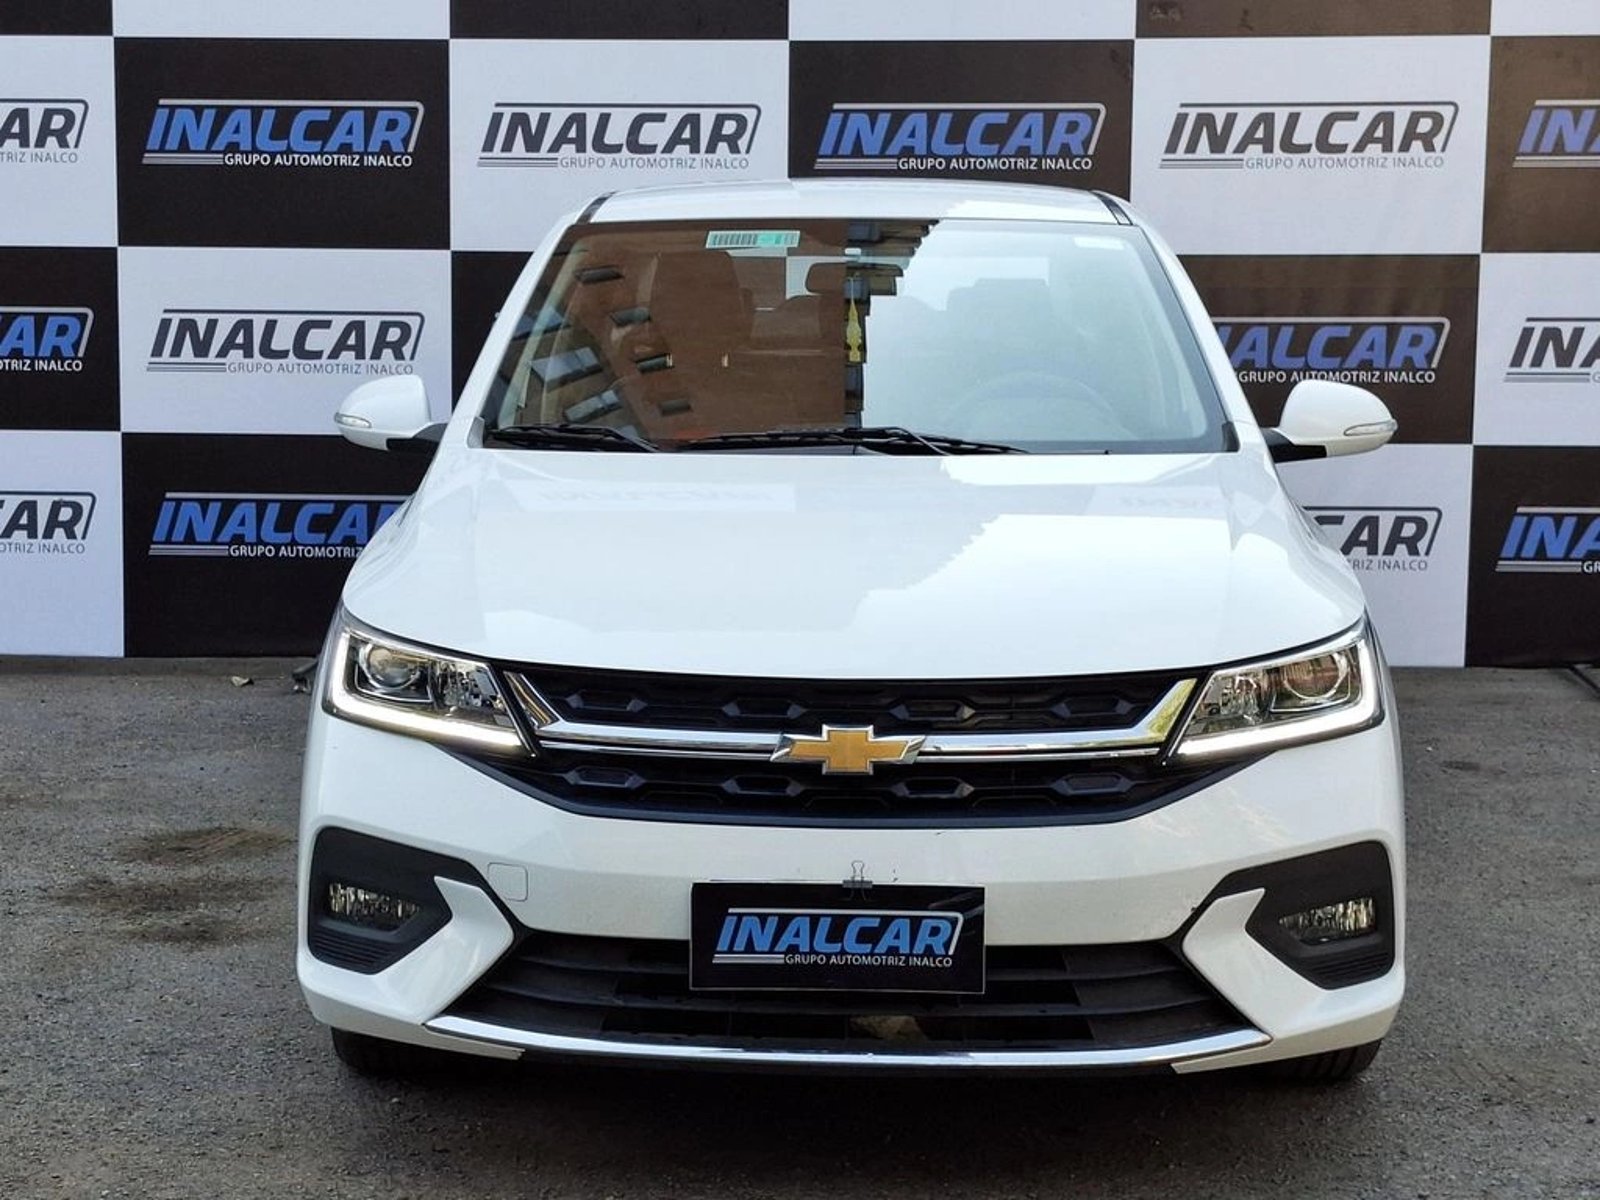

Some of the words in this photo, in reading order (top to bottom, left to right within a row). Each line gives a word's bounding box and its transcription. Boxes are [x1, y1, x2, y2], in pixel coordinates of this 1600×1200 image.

[145, 108, 412, 153] INALCAR
[481, 112, 749, 154] INALCAR
[817, 112, 1094, 156] INALCAR
[1163, 111, 1446, 154] INALCAR
[1518, 108, 1600, 153] IN
[30, 151, 79, 163] INALCO
[223, 153, 272, 166] GRUPO
[274, 154, 361, 168] AUTOMOTRIZ
[363, 155, 413, 168] INALCO
[559, 157, 606, 169] GRUPO
[609, 157, 697, 169] AUTOMOTRIZ
[700, 157, 749, 170] INALCO
[898, 157, 946, 170] GRUPO
[949, 157, 1038, 170] AUTOMOTRIZ
[1041, 157, 1092, 170] INALCO
[1245, 158, 1295, 170] GRUPO
[1298, 157, 1389, 170] AUTOMOTRIZ
[1392, 156, 1445, 169] INALCO
[0, 315, 81, 357] AR
[150, 318, 413, 361] INALCAR
[1219, 325, 1437, 369] ALCAR
[34, 359, 83, 372] INALCO
[227, 361, 274, 374] GRUPO
[276, 362, 362, 375] AUTOMOTRIZ
[365, 363, 414, 376] INALCO
[1238, 371, 1287, 383] GRUPO
[1290, 371, 1380, 383] AUTOMOTRIZ
[1383, 371, 1436, 384] INALCO
[0, 500, 84, 540] AR
[38, 542, 86, 554] INALCO
[229, 545, 276, 558] GRUPO
[1377, 559, 1428, 572] INALCO
[716, 916, 953, 955] INALCAR
[785, 954, 827, 965] GRUPO
[829, 955, 906, 967] AUTOMOTRIZ
[908, 956, 953, 968] INALCO
